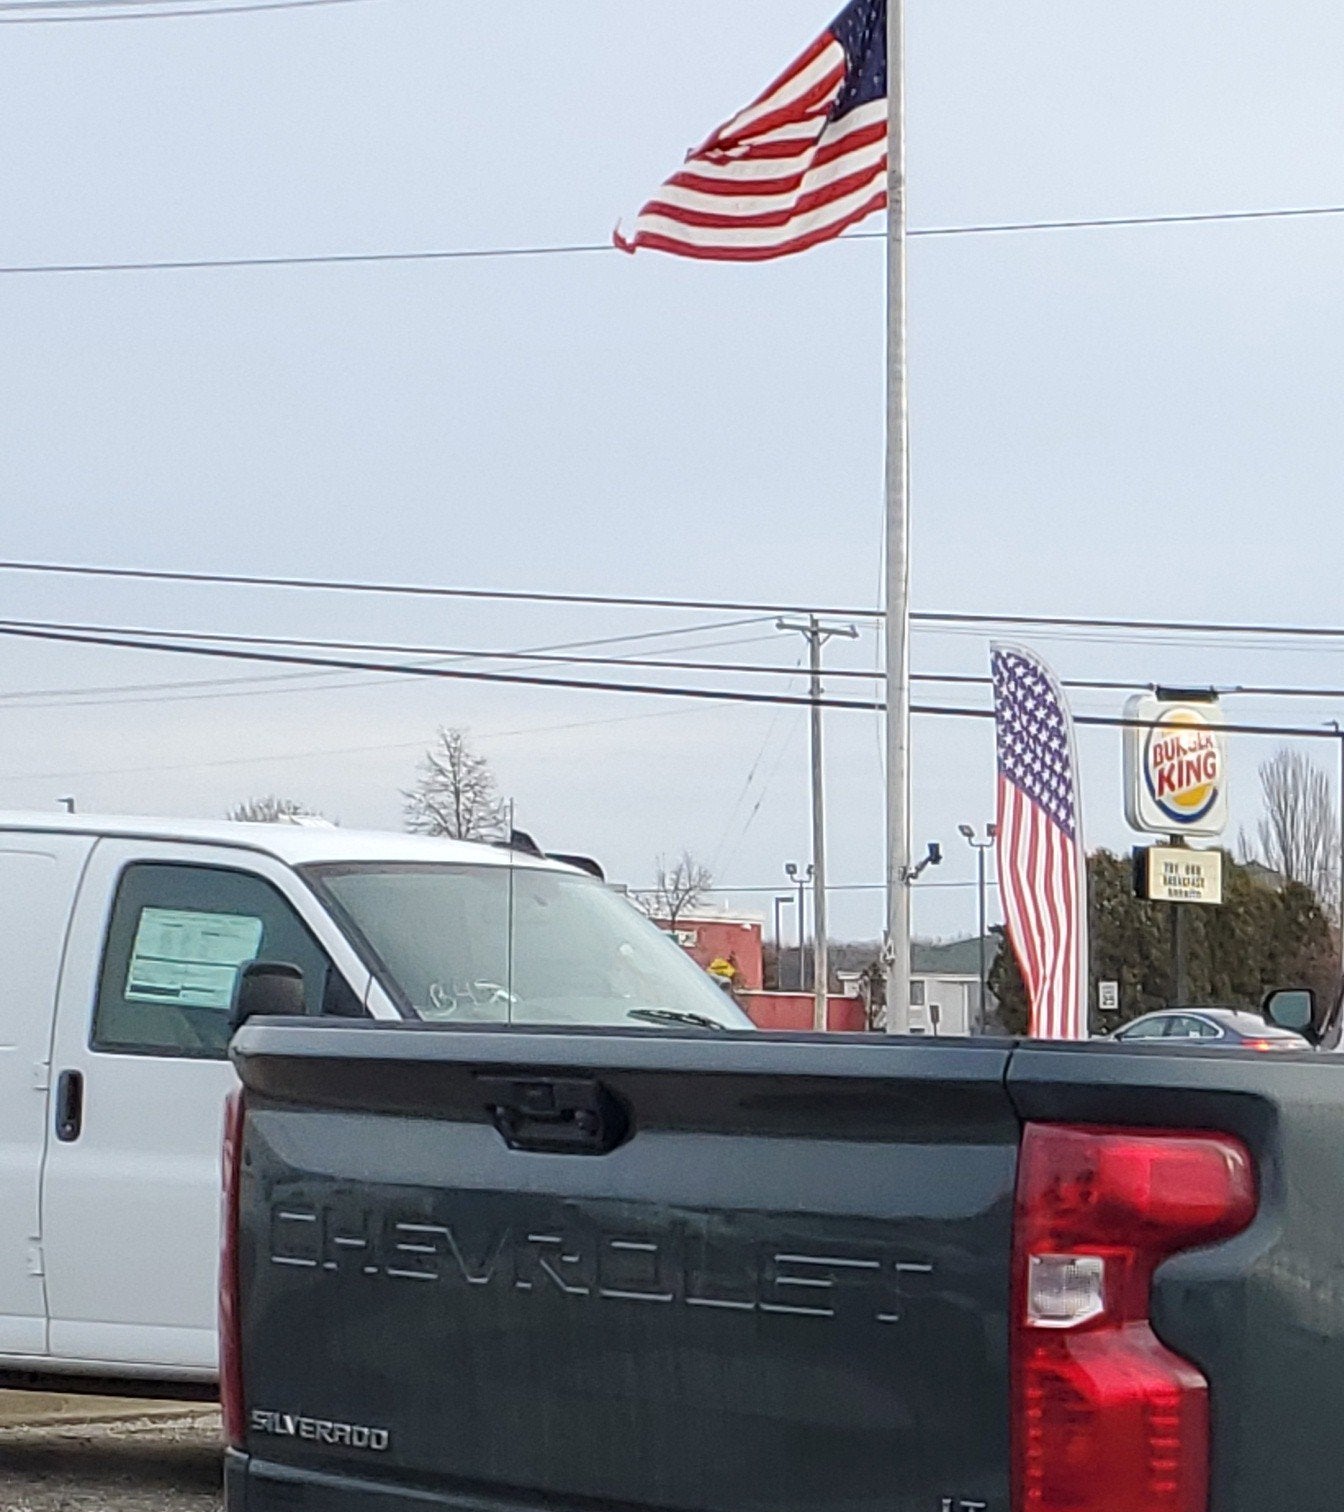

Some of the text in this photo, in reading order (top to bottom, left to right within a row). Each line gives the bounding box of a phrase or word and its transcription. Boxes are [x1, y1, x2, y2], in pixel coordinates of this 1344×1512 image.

[1158, 750, 1216, 797] KING
[269, 1205, 933, 1322] CHEVROLET
[251, 1409, 389, 1451] SILVERADO
